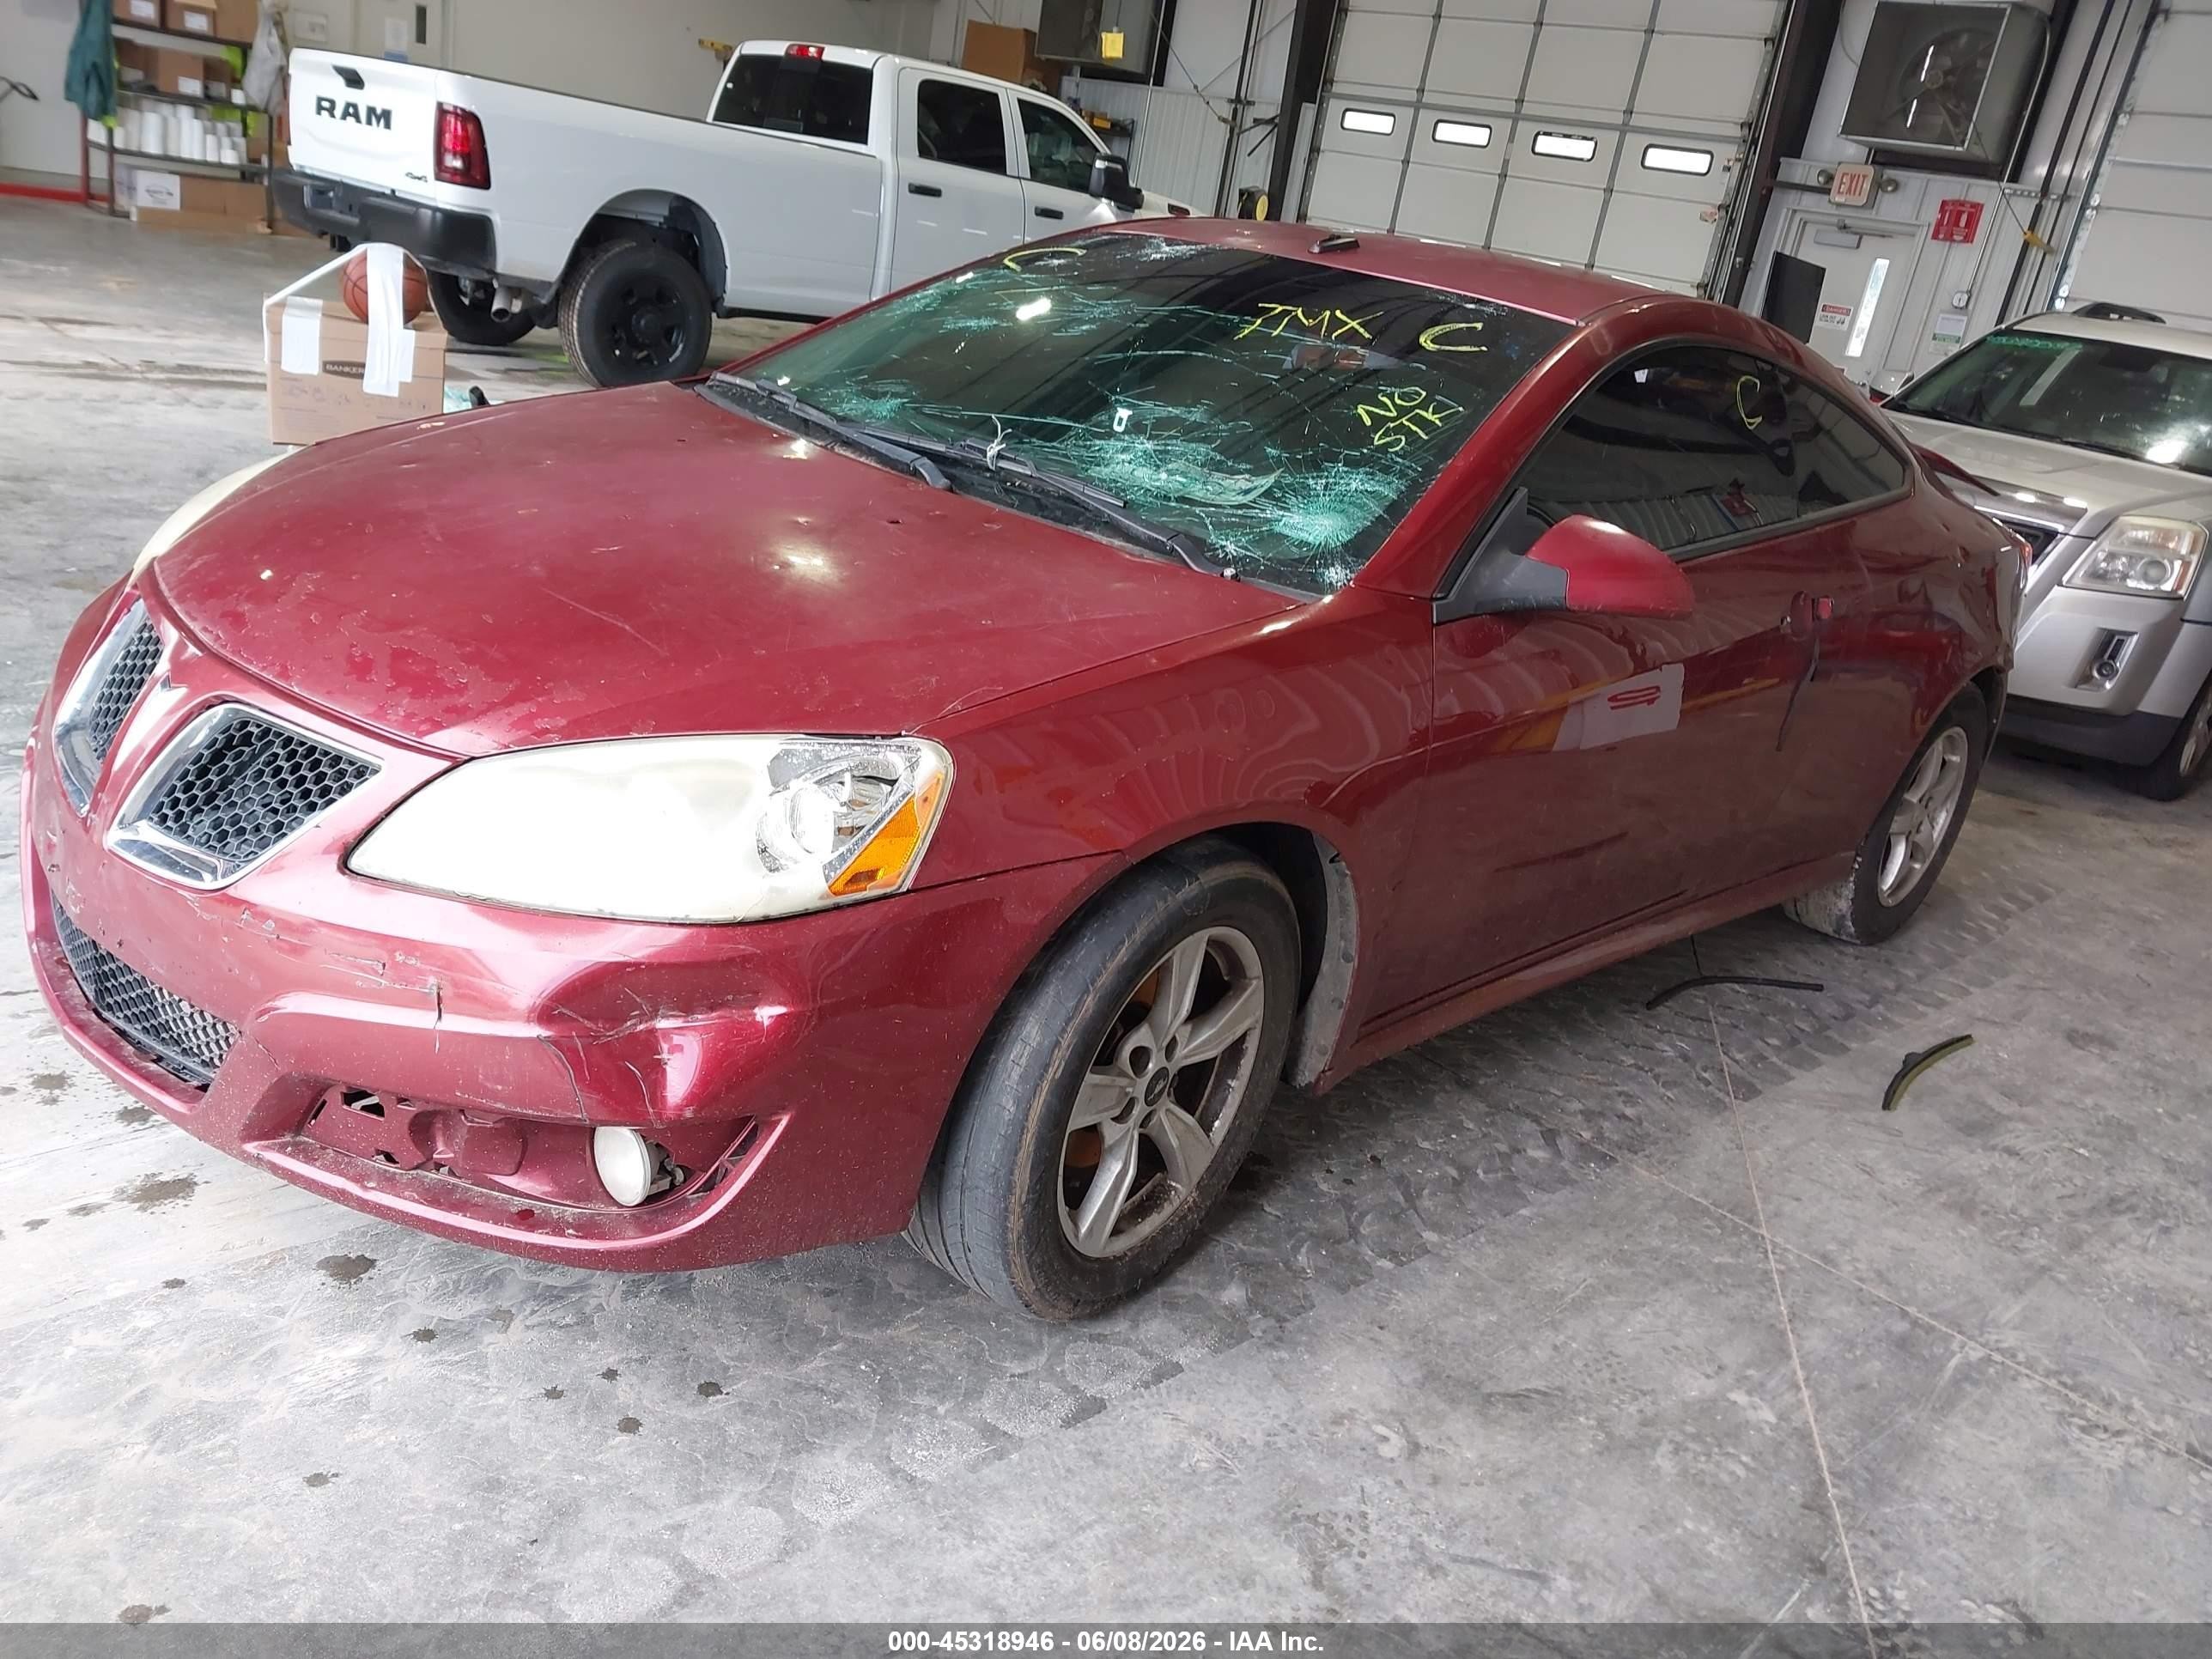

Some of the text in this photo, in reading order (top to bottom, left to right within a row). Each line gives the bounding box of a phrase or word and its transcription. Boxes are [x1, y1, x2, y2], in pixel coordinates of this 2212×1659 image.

[315, 94, 392, 131] RAM
[1837, 173, 1869, 197] EXIT
[1419, 321, 1489, 353] C
[1357, 386, 1427, 427] NO
[1736, 374, 1763, 430] C
